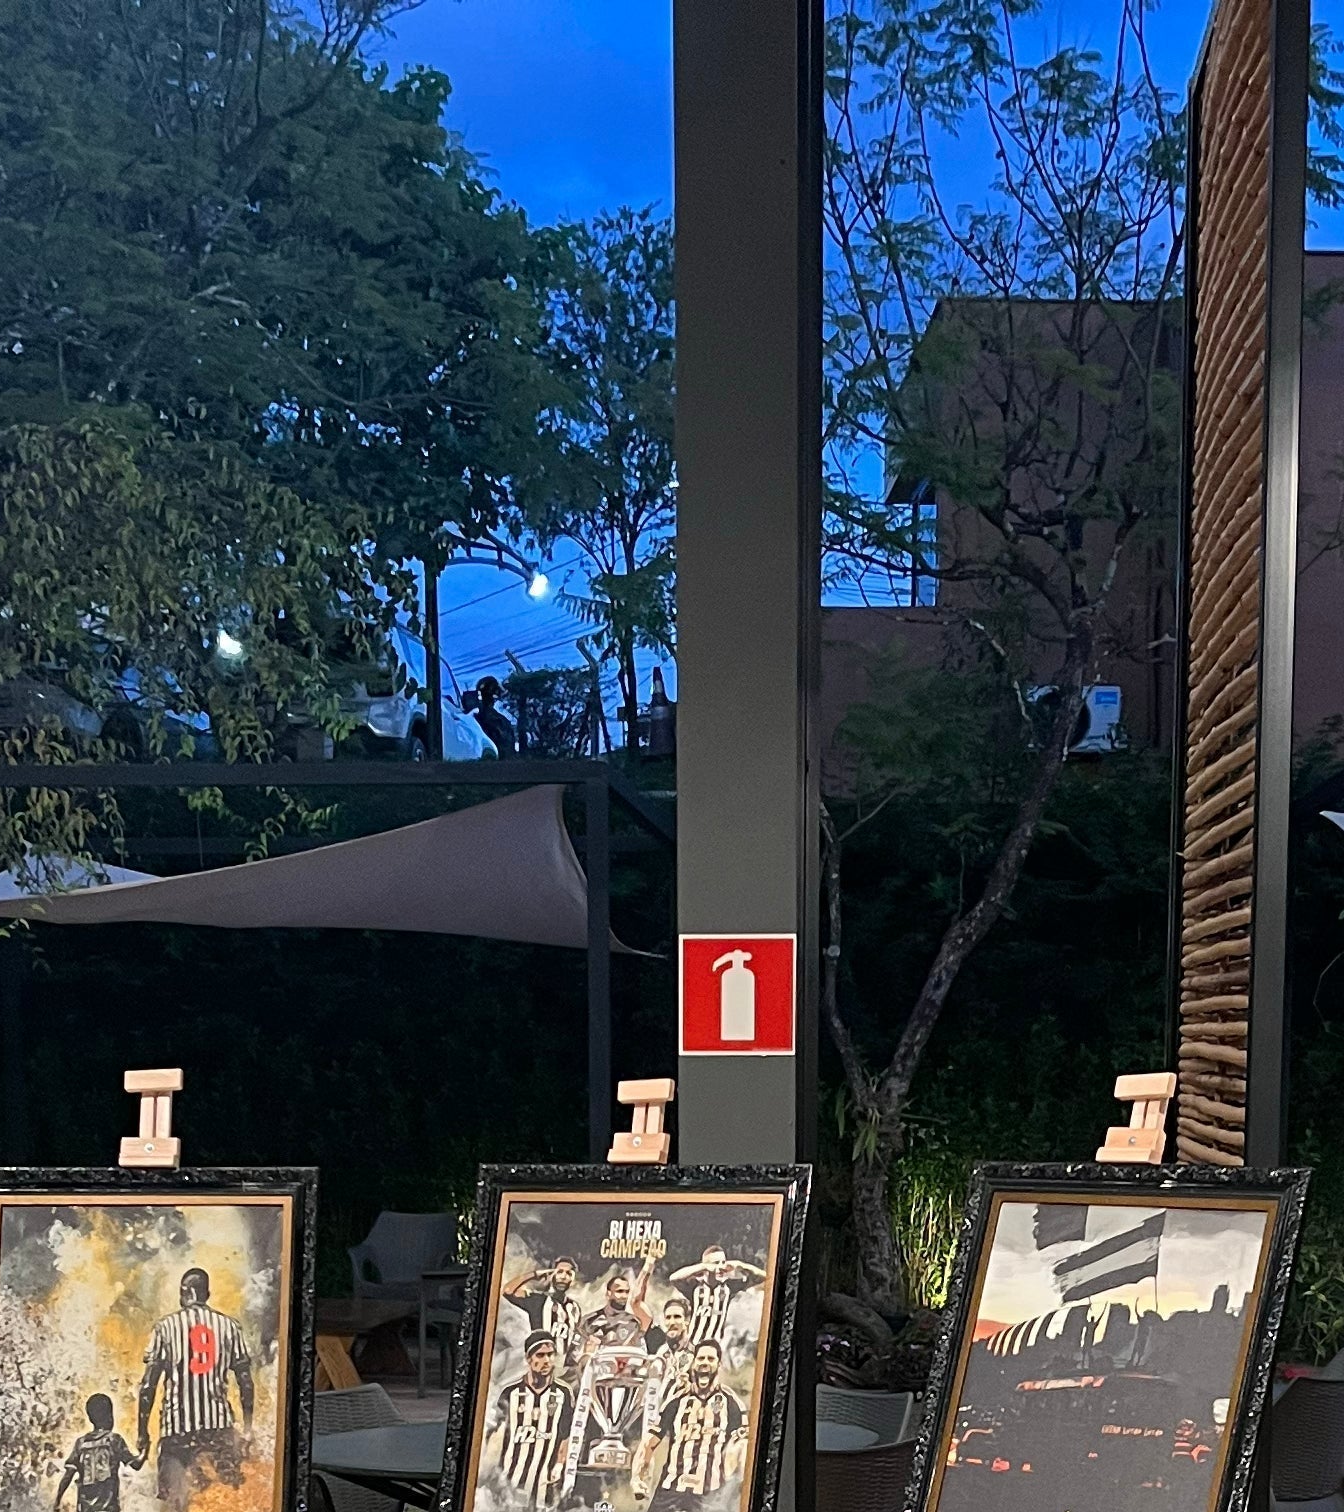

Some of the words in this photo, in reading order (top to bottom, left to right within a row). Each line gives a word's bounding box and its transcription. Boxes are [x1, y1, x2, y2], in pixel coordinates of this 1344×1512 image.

[609, 1220, 624, 1240] BI
[625, 1220, 662, 1240] HEXA
[189, 1323, 216, 1375] 9
